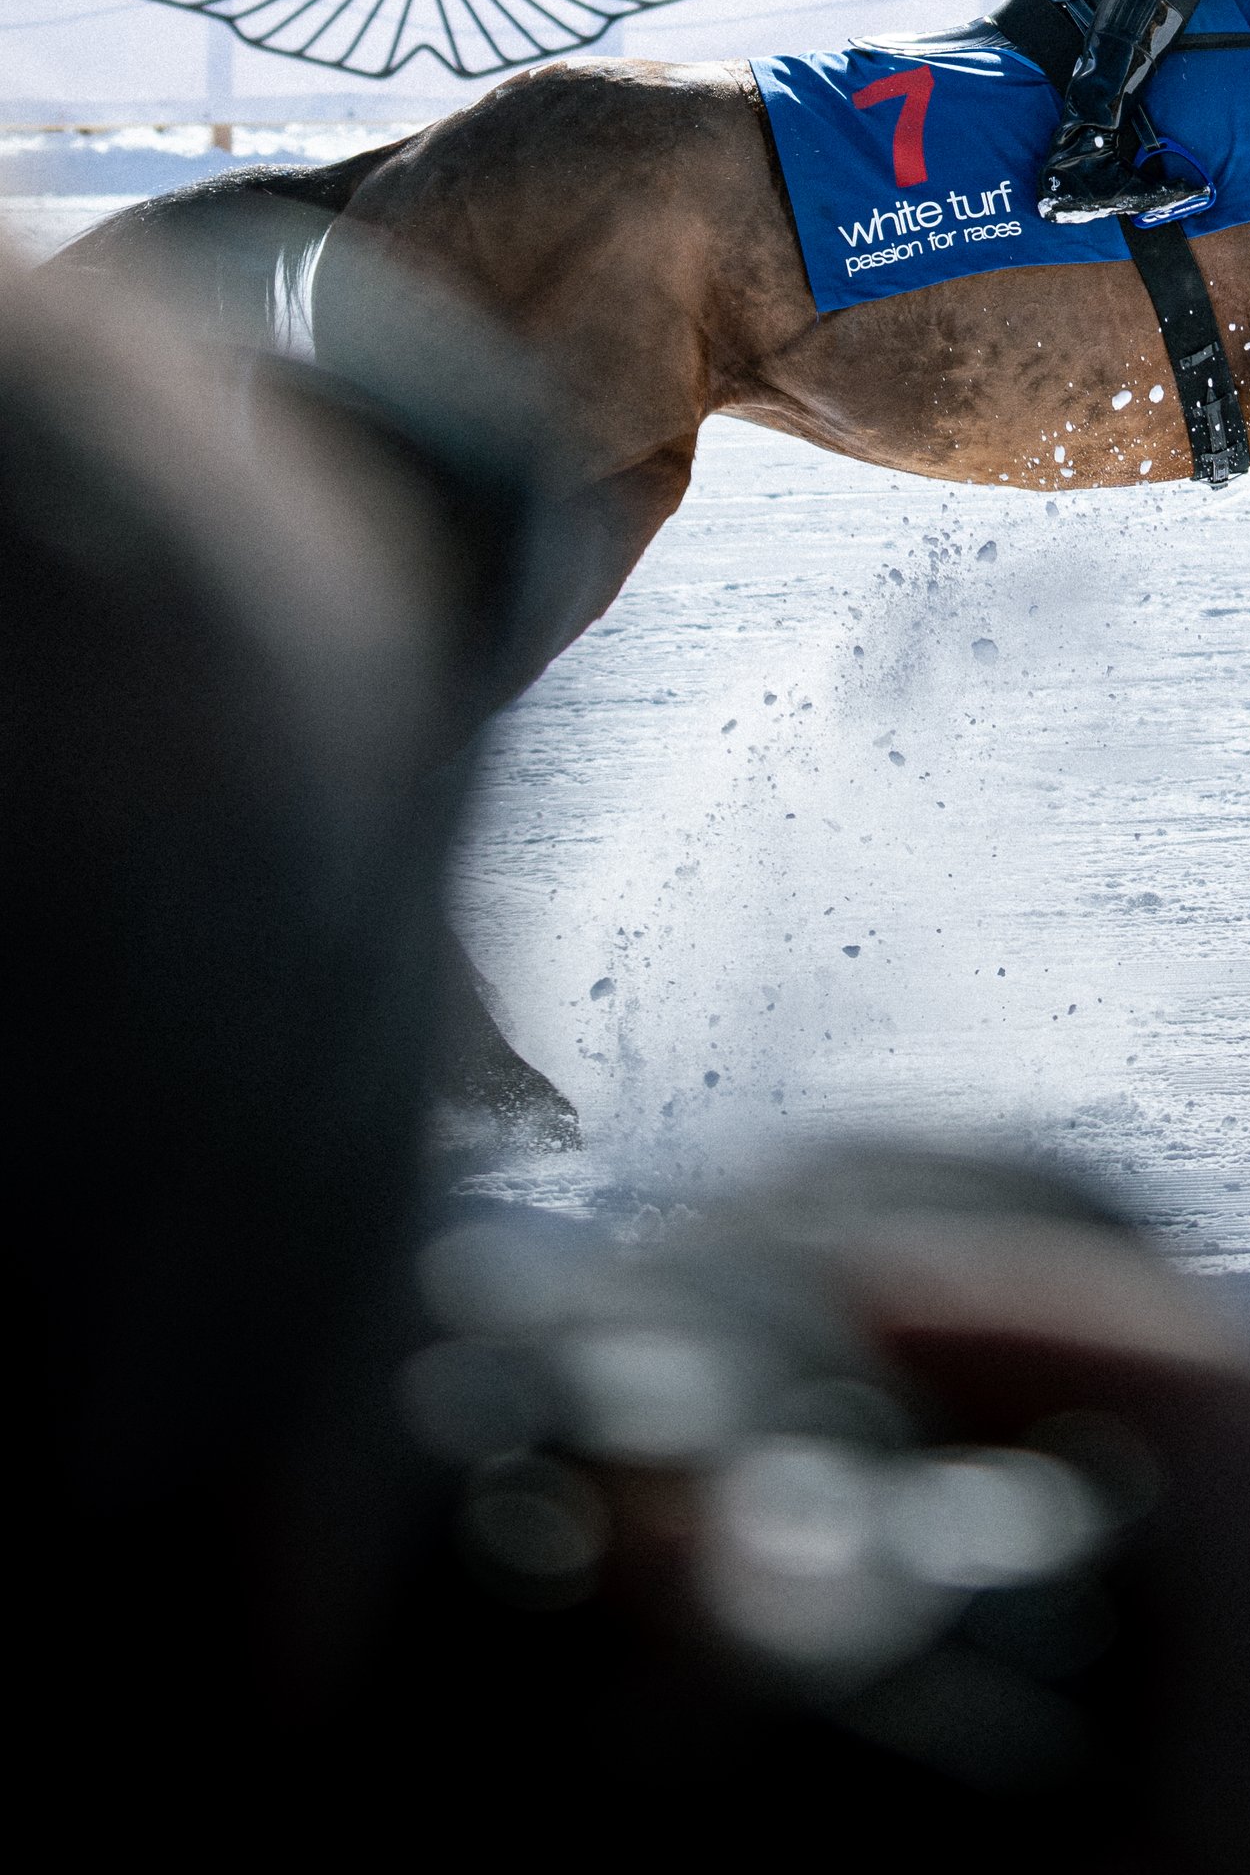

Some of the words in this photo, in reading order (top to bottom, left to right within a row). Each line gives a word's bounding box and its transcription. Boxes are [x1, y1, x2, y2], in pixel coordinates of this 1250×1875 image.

[852, 65, 935, 188] 7
[838, 200, 943, 247] white
[946, 180, 1012, 220] turf
[845, 242, 924, 277] passion
[927, 231, 957, 251] for
[963, 220, 1022, 243] races
